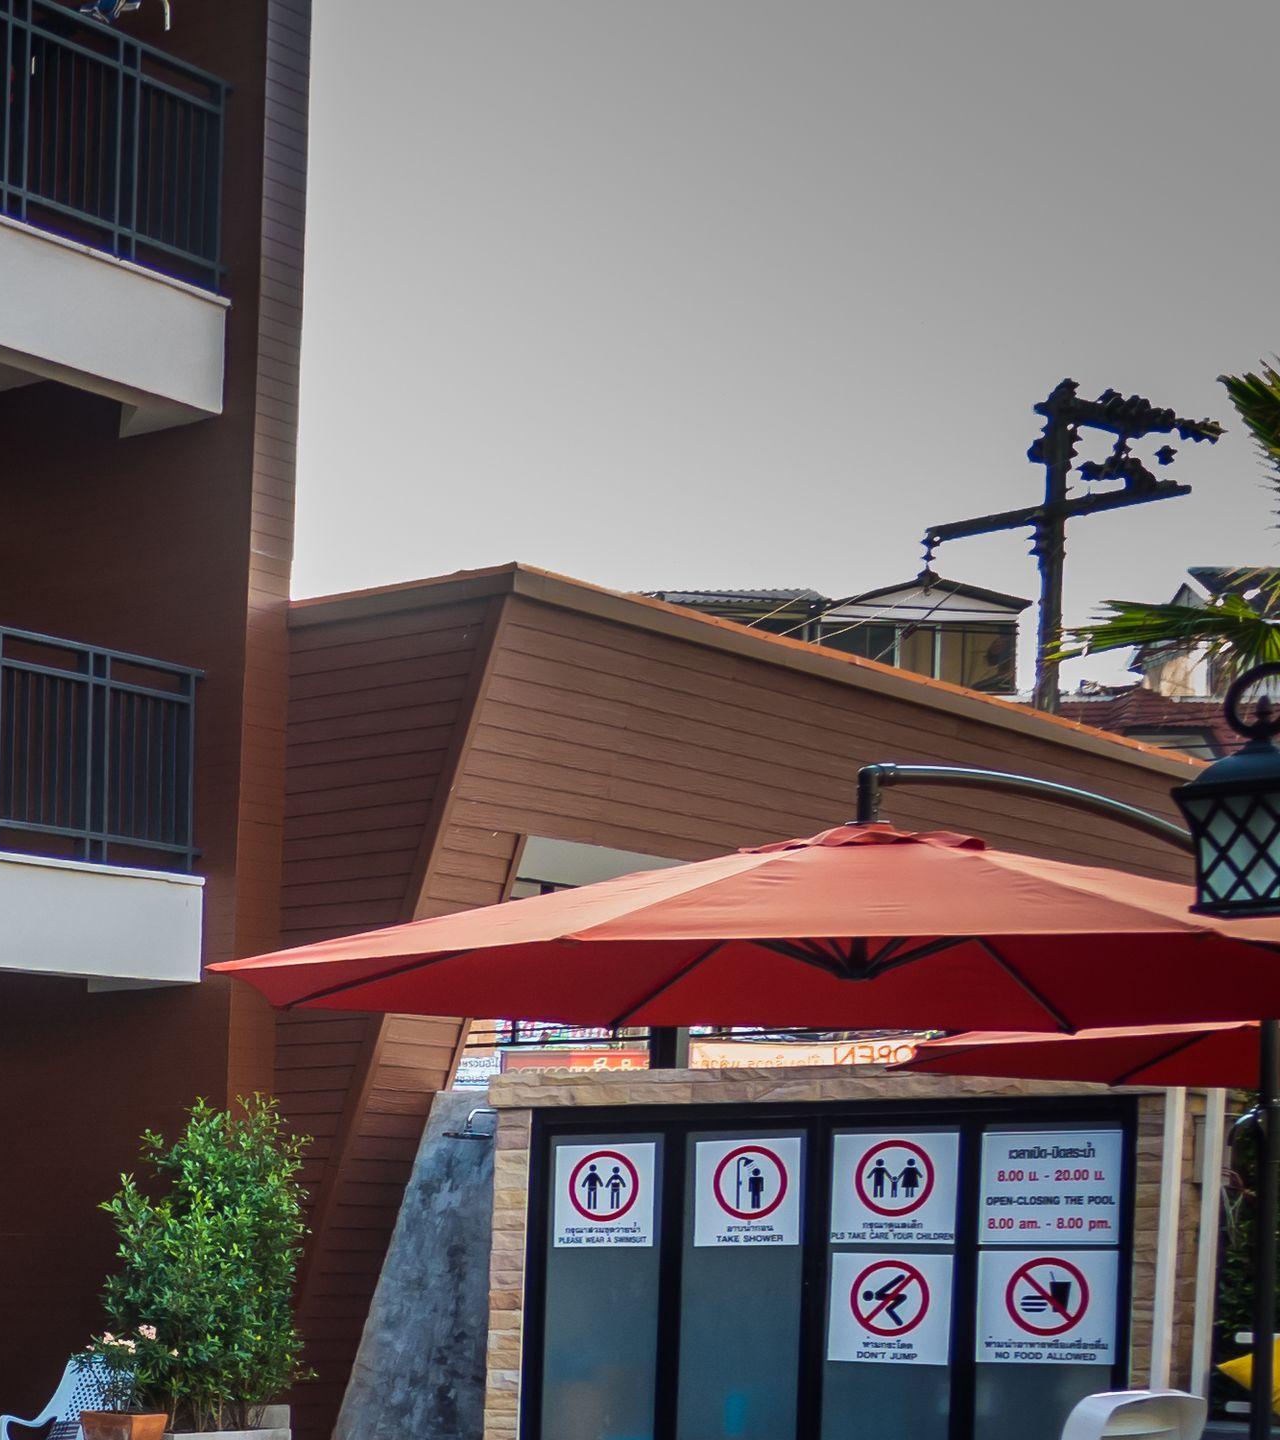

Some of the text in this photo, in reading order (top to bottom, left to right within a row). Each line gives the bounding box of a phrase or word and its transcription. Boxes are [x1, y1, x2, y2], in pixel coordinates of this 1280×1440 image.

[997, 1170, 1024, 1182] 8.00
[1028, 1171, 1039, 1181] น.
[1055, 1169, 1089, 1181] 20.00
[1094, 1170, 1105, 1181] น.
[986, 1196, 1115, 1206] OPEN-CLOSING THE POOL
[987, 1218, 1014, 1229] 8.00
[1019, 1220, 1040, 1229] am.
[1056, 1218, 1083, 1229] 8.00
[1088, 1219, 1111, 1231] pm.
[558, 1236, 583, 1244] PLEASE
[716, 1234, 783, 1243] TAKE SHOWER
[831, 1232, 954, 1241] PLS TAKE CARE YOUR CHILDREN
[856, 1351, 918, 1360] DON'T JUMP
[995, 1351, 1097, 1361] NO FOOD ALLOWED
